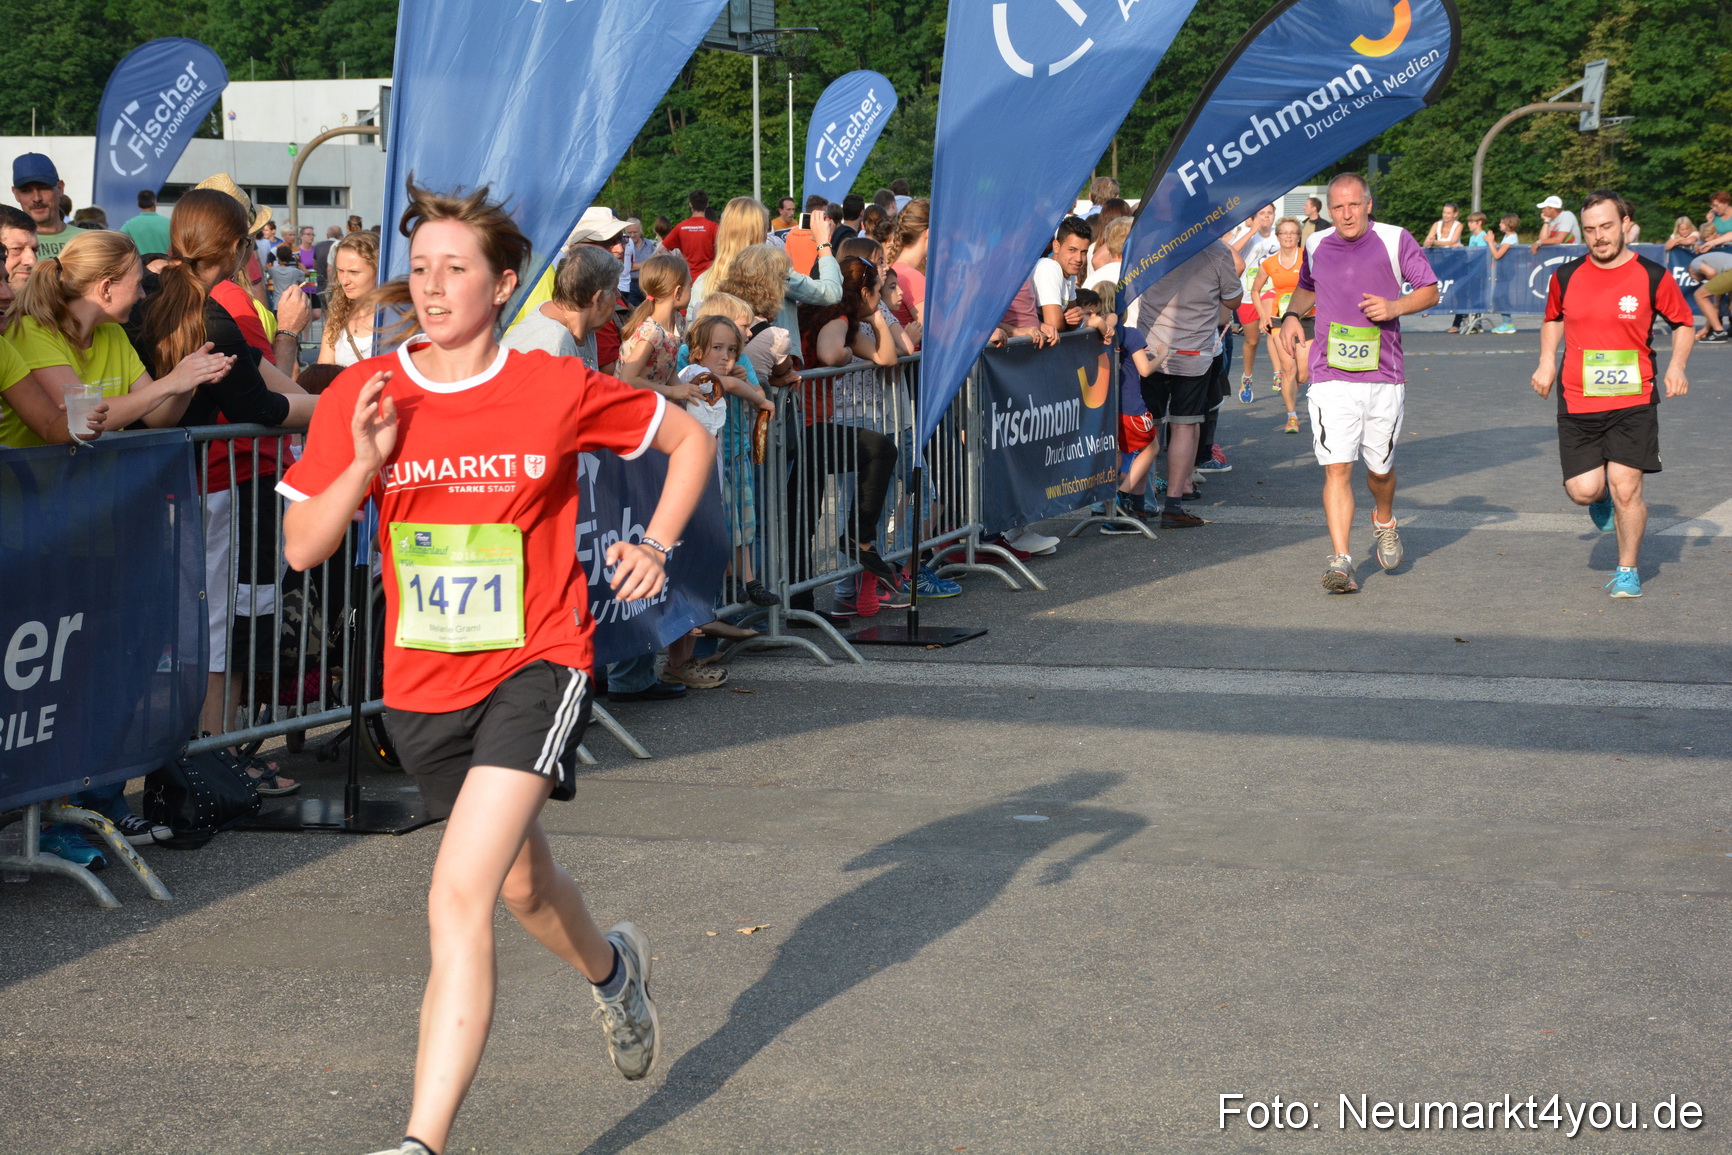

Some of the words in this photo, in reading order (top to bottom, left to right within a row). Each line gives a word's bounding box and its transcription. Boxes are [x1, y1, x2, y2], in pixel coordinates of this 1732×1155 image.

[127, 60, 199, 160] Fischer
[153, 79, 208, 159] AUTOMOBILE
[1303, 103, 1351, 140] Druck
[1382, 48, 1440, 93] Medien
[827, 88, 877, 169] Fischer
[844, 102, 883, 167] AUTOMOBILE
[1176, 63, 1374, 198] Frischmann
[1337, 343, 1369, 359] 326
[1594, 369, 1629, 385] 252
[991, 393, 1081, 450] Frischmann
[1045, 441, 1066, 467] Druck
[1066, 436, 1085, 461] und
[448, 485, 485, 493] STARKE
[487, 485, 516, 493] STADT
[409, 573, 502, 615] 1471
